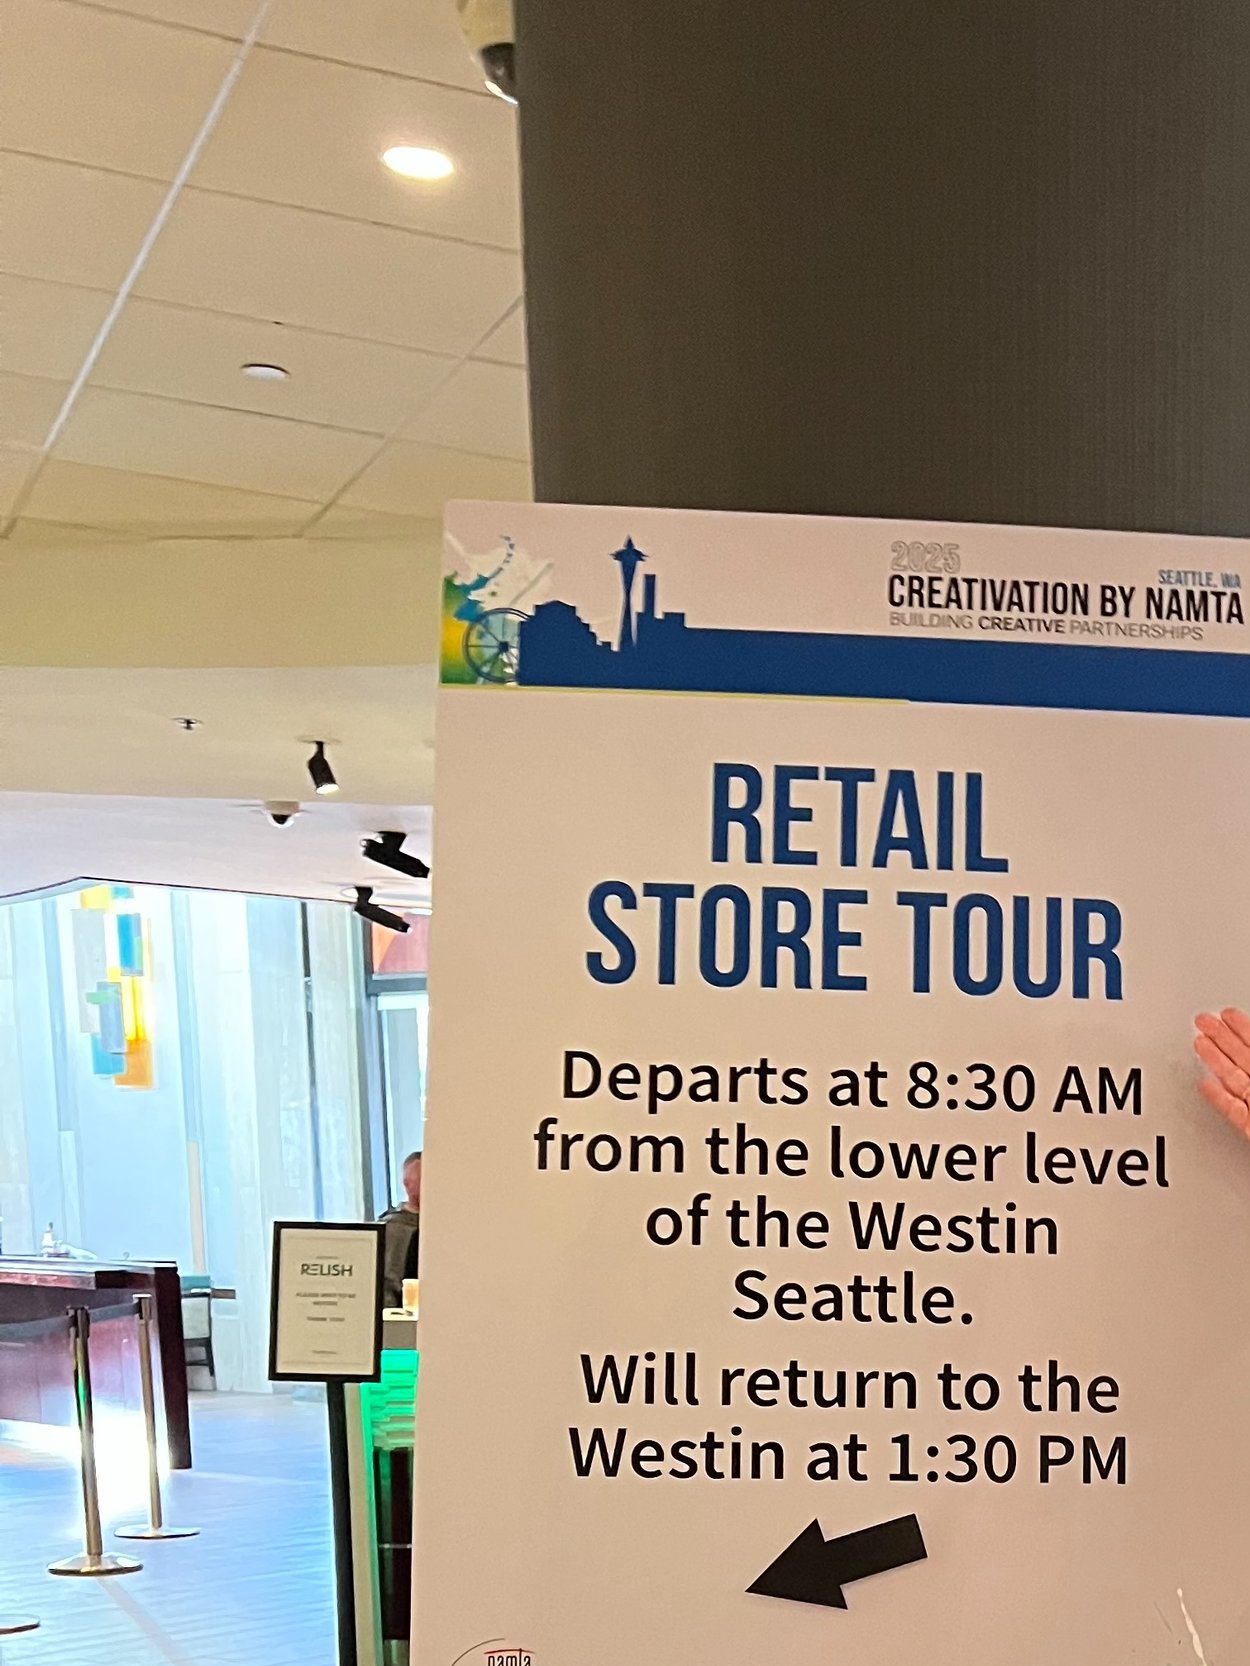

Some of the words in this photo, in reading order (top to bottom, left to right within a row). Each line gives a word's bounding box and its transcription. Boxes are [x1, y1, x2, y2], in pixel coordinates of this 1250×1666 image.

[890, 540, 961, 574] 2025
[1220, 572, 1242, 589] WA
[888, 574, 1089, 616] CREATIVATION
[1099, 584, 1136, 619] BY
[1145, 586, 1245, 625] NAMTA
[889, 611, 974, 630] BUILDING
[977, 615, 1067, 635] CREATIVE
[1069, 618, 1204, 642] PARTNERSHIPS
[712, 763, 1008, 873] RETAIL
[587, 881, 868, 991] STORE
[897, 891, 1123, 1000] TOUR
[564, 1051, 808, 1115] Departs
[829, 1060, 887, 1107] at
[908, 1062, 1035, 1112] 8:30
[1053, 1066, 1143, 1116] AM
[534, 1118, 684, 1172] from
[705, 1123, 808, 1176] the
[831, 1126, 1006, 1181] lower
[1026, 1132, 1169, 1187] level
[646, 1194, 711, 1246] of
[726, 1196, 829, 1249] the
[848, 1200, 1058, 1254] Westin
[300, 1263, 353, 1277] RELISH
[732, 1270, 973, 1325] Seattle.
[580, 1352, 699, 1406] Will
[720, 1360, 917, 1411] return
[938, 1364, 999, 1412] to
[1018, 1362, 1120, 1414] the
[568, 1426, 784, 1480] Westin
[807, 1434, 868, 1482] at
[889, 1434, 1017, 1484] 1:30
[1039, 1435, 1127, 1485] PM
